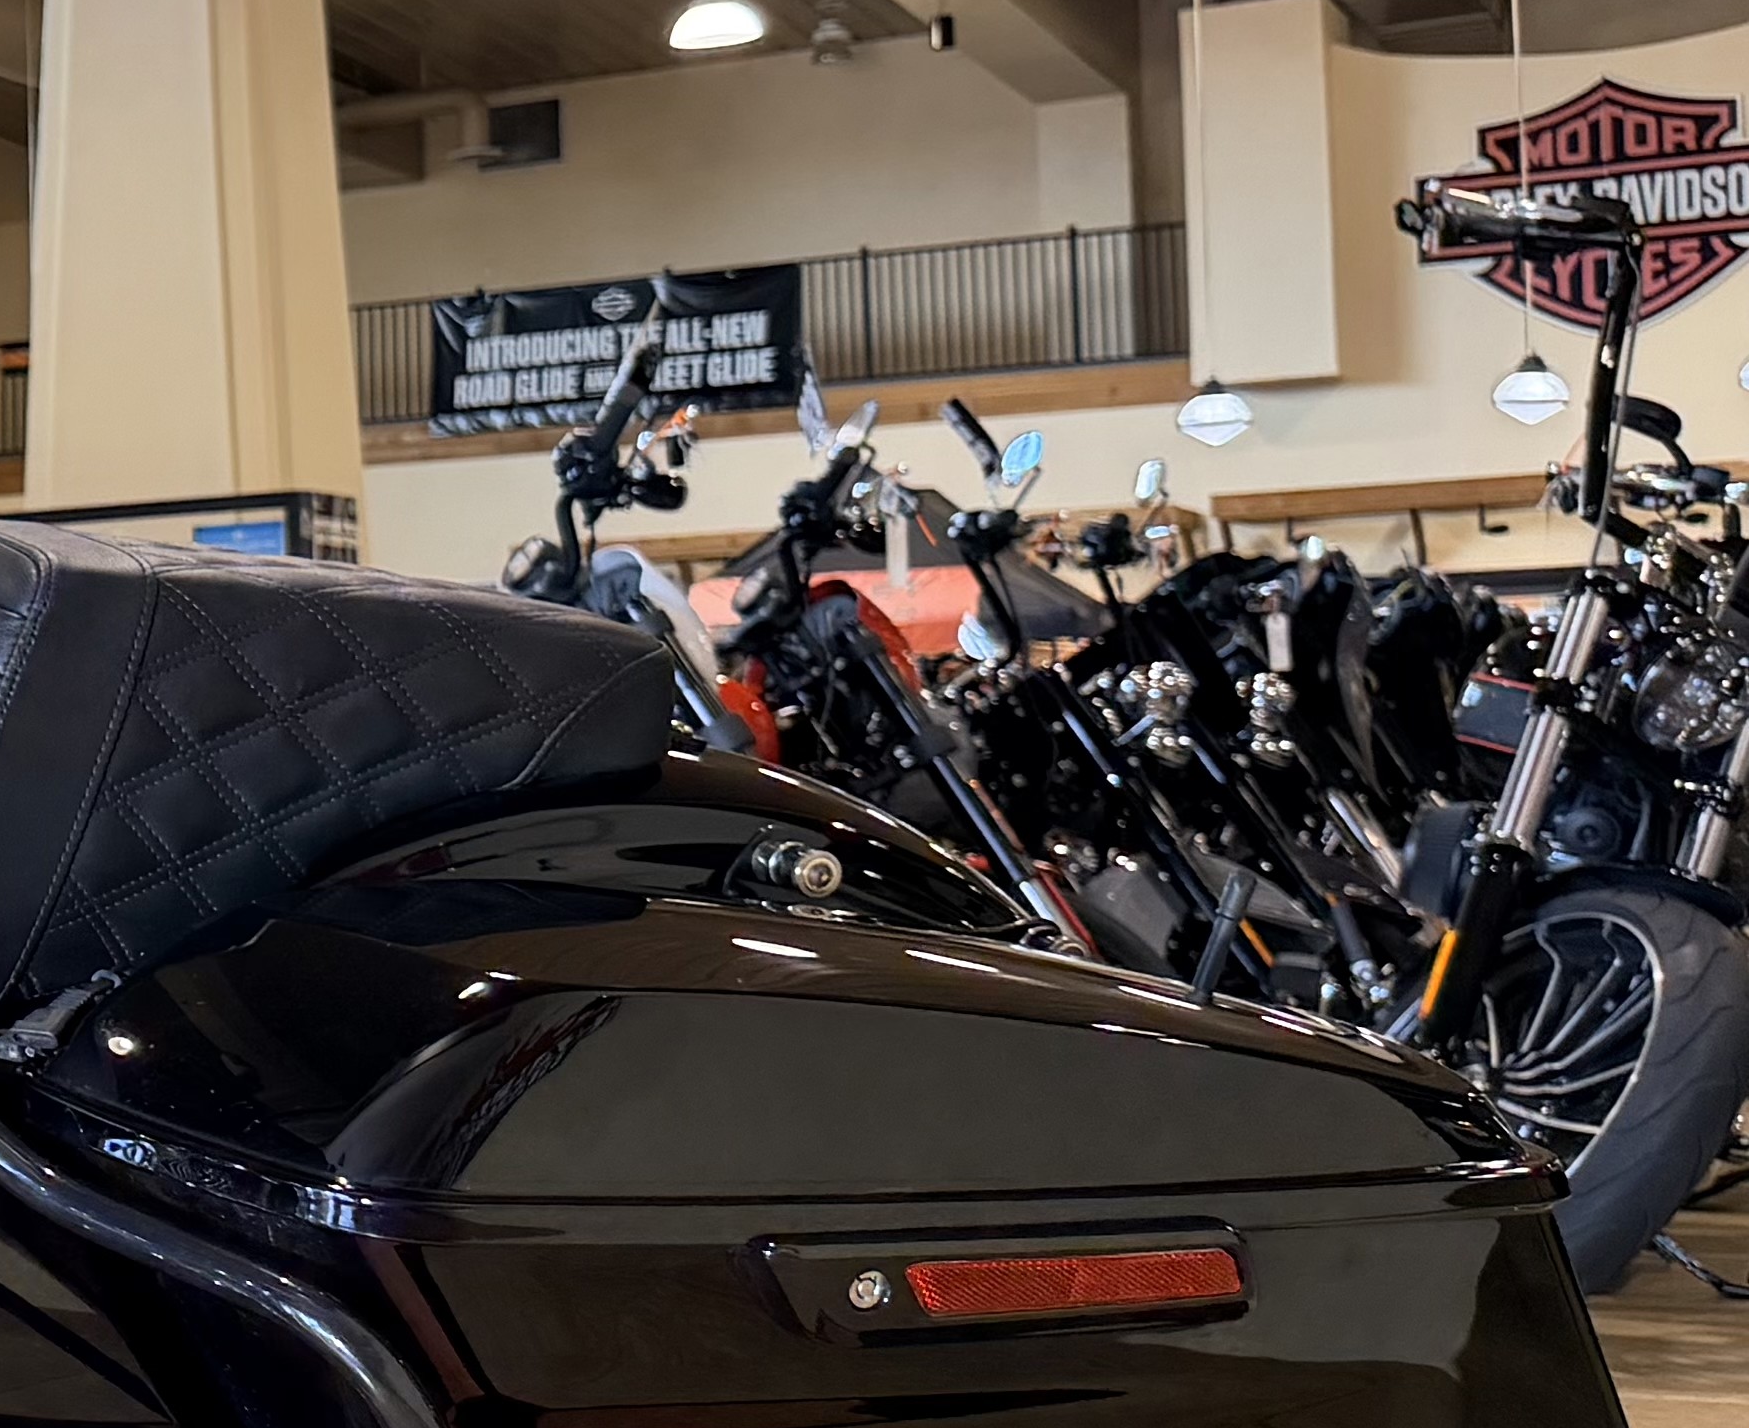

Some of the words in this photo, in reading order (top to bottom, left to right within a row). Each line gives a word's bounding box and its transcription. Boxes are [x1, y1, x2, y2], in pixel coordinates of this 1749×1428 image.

[1522, 104, 1698, 167] MOTOR
[465, 324, 618, 373] INTRODUCING
[617, 319, 663, 356] TE
[664, 308, 771, 355] ALL-NEW
[453, 372, 513, 411] ROAD
[514, 365, 583, 404] GLIDE
[706, 346, 779, 387] GLIDE
